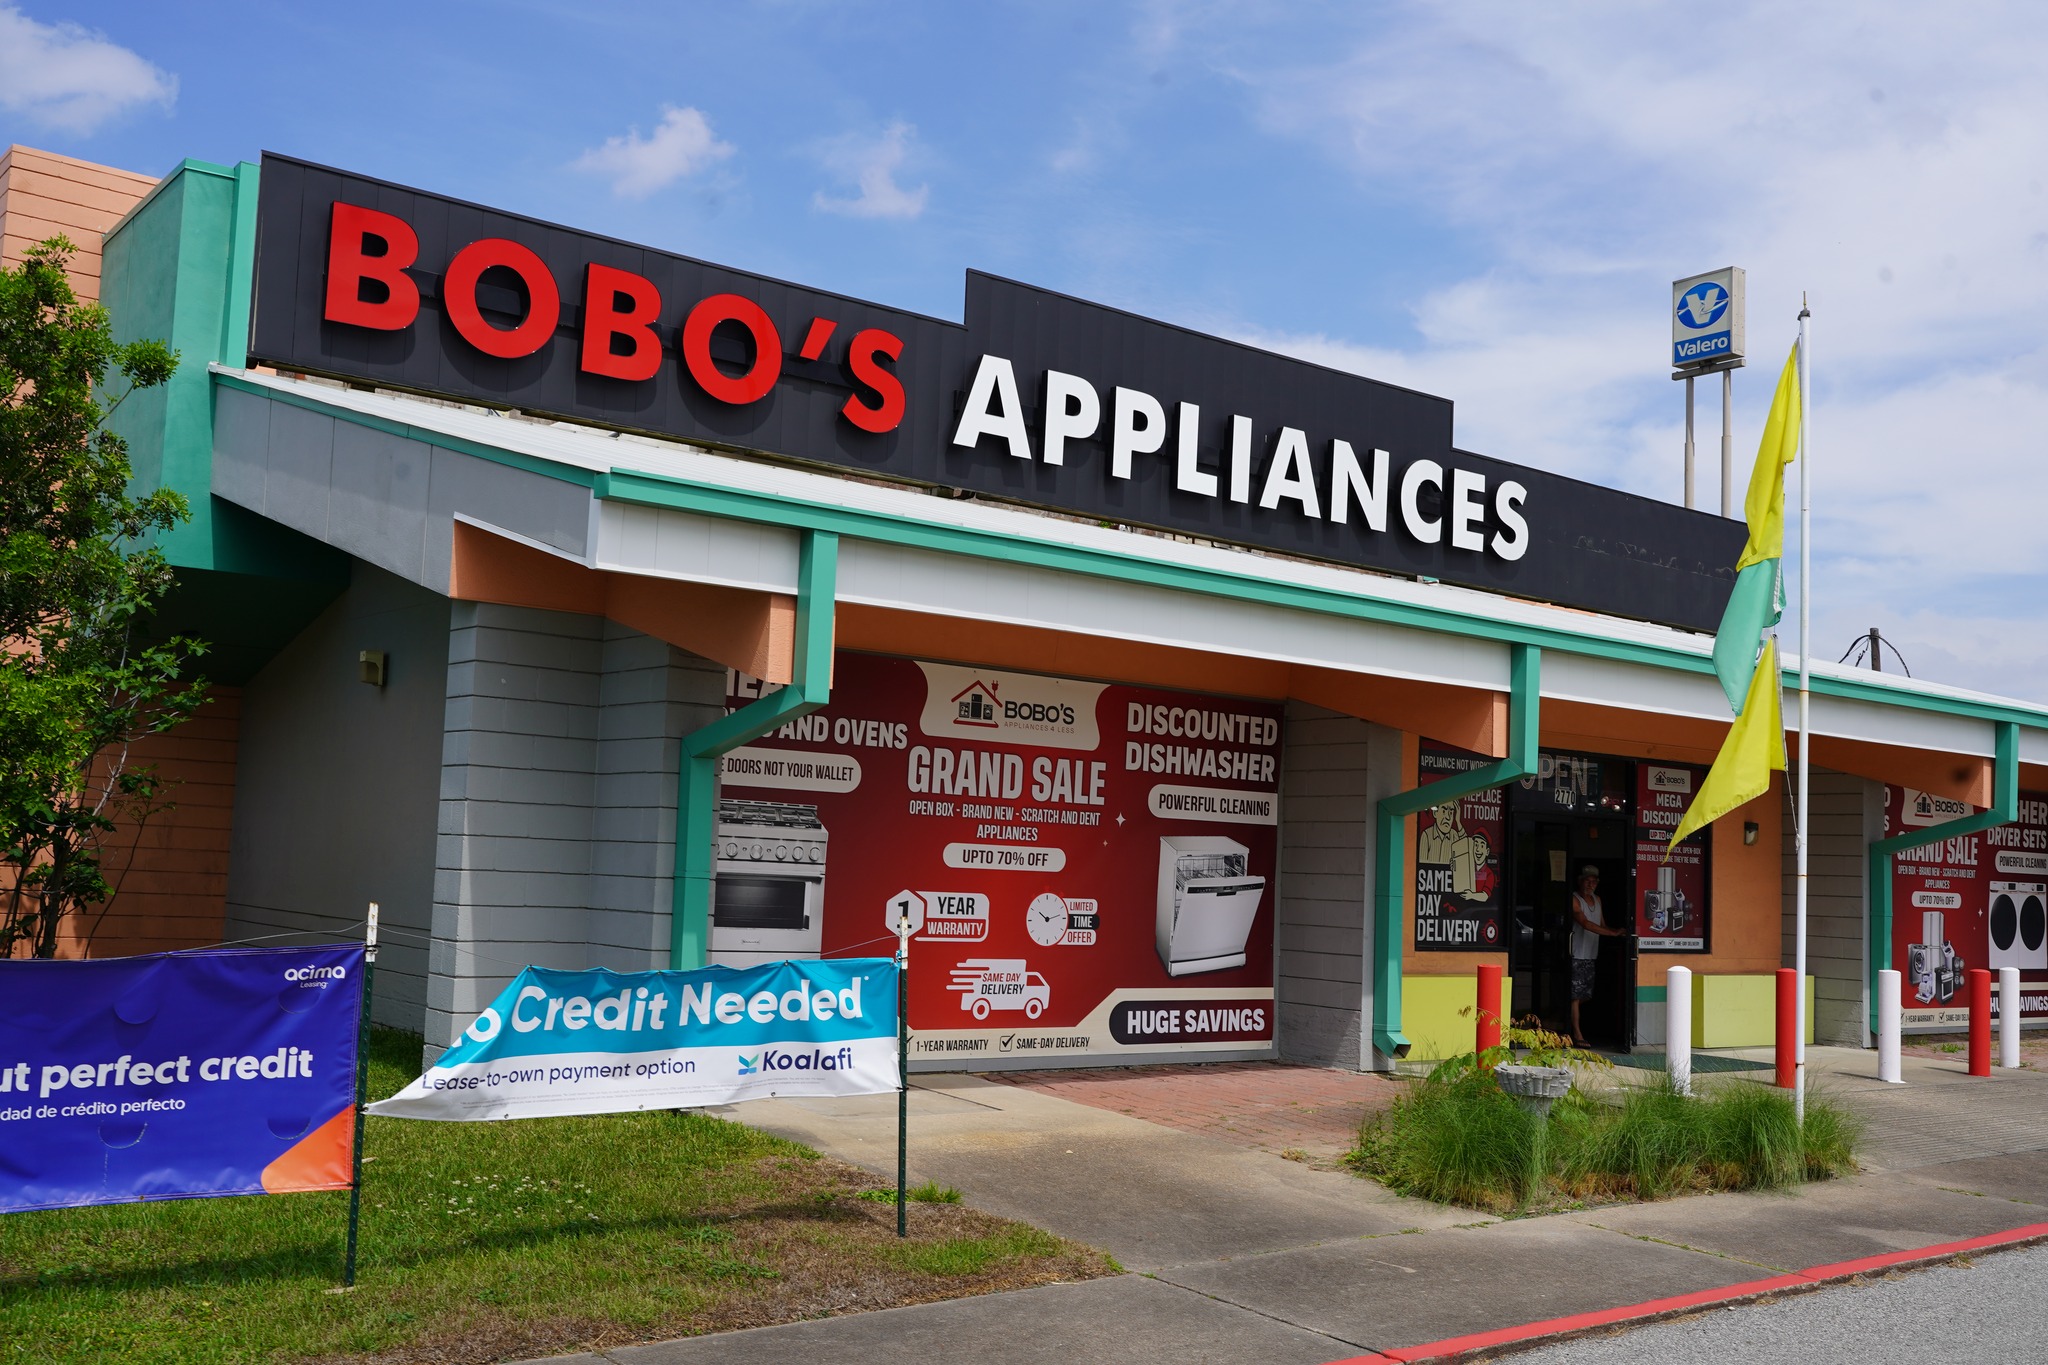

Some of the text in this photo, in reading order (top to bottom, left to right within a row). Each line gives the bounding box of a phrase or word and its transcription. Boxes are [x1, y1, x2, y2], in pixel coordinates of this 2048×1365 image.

[325, 201, 906, 433] BOBO'S
[1677, 336, 1728, 357] Valero
[953, 354, 1528, 561] APPLIANCES
[1004, 700, 1075, 725] BOBO'S
[778, 714, 908, 750] AND OVENS
[1004, 722, 1049, 732] APPLIANCES
[1127, 702, 1278, 746] DISCOUNTED
[727, 757, 762, 775] DOORS
[764, 760, 784, 777] NOT
[787, 762, 812, 779] YOUR
[815, 765, 854, 782] WALLET
[1125, 741, 1275, 783] DISHWASHER
[1421, 755, 1455, 769] APPLIANCE
[1456, 758, 1469, 770] NOT
[907, 745, 1106, 806] GRAND SALE
[1159, 793, 1270, 817] POWERFUL CLEANING
[1555, 789, 1576, 804] 2770
[1656, 793, 1682, 808] MEGA
[909, 800, 933, 816] OPEN
[936, 802, 954, 817] BOX
[962, 804, 992, 820] BRAND
[994, 806, 1014, 821] NEW
[1021, 808, 1059, 824] SCRATCH
[1060, 811, 1077, 825] AND
[1080, 812, 1100, 826] DENT
[1464, 804, 1472, 819] IT
[1935, 800, 1965, 814] BOBO'S
[976, 824, 1038, 841] APPLIANCES
[1987, 826, 2047, 849] DRYER SETS
[962, 849, 1048, 866] UPTO 70% OFF
[1946, 835, 1979, 866] SALE
[1898, 865, 1908, 874] OPEN
[1908, 866, 1916, 875] BOX
[1919, 866, 1931, 876] BRAND
[1931, 867, 1940, 876] NEW
[1943, 868, 1958, 877] SCRATCH
[1959, 869, 1967, 878] AND
[1967, 869, 1976, 878] DENT
[1999, 856, 2047, 869] POWERFUL CLEANING
[1418, 869, 1452, 892] SAME
[1925, 879, 1950, 889] APPLIANCES
[937, 896, 975, 915] YEAR
[1069, 902, 1093, 911] LIMITED
[1418, 893, 1441, 916] DAY
[1919, 895, 1954, 905] UPTO 70% OFF
[927, 921, 983, 936] WARRANTY
[1073, 916, 1092, 928] TIME
[1417, 918, 1479, 942] DELIVERY
[1067, 931, 1092, 943] OFFER
[284, 964, 346, 981] acima
[982, 973, 1021, 982] SAME DAY
[981, 984, 1025, 995] DELIVERY
[511, 985, 668, 1033] Credit
[2019, 996, 2048, 1012] AVINGS
[1127, 1008, 1265, 1034] HUGE SAVINGS
[916, 1036, 1090, 1052] 1-YEAR WARRANTY SAME-DAY DELIVERY
[762, 1047, 853, 1072] Koalafi
[39, 1055, 191, 1098] perfect
[199, 1046, 313, 1082] credit
[422, 1057, 695, 1090] Lease-to-own payment option
[35, 1105, 57, 1118] de
[61, 1101, 117, 1116] crédito
[120, 1098, 186, 1115] perfecto
